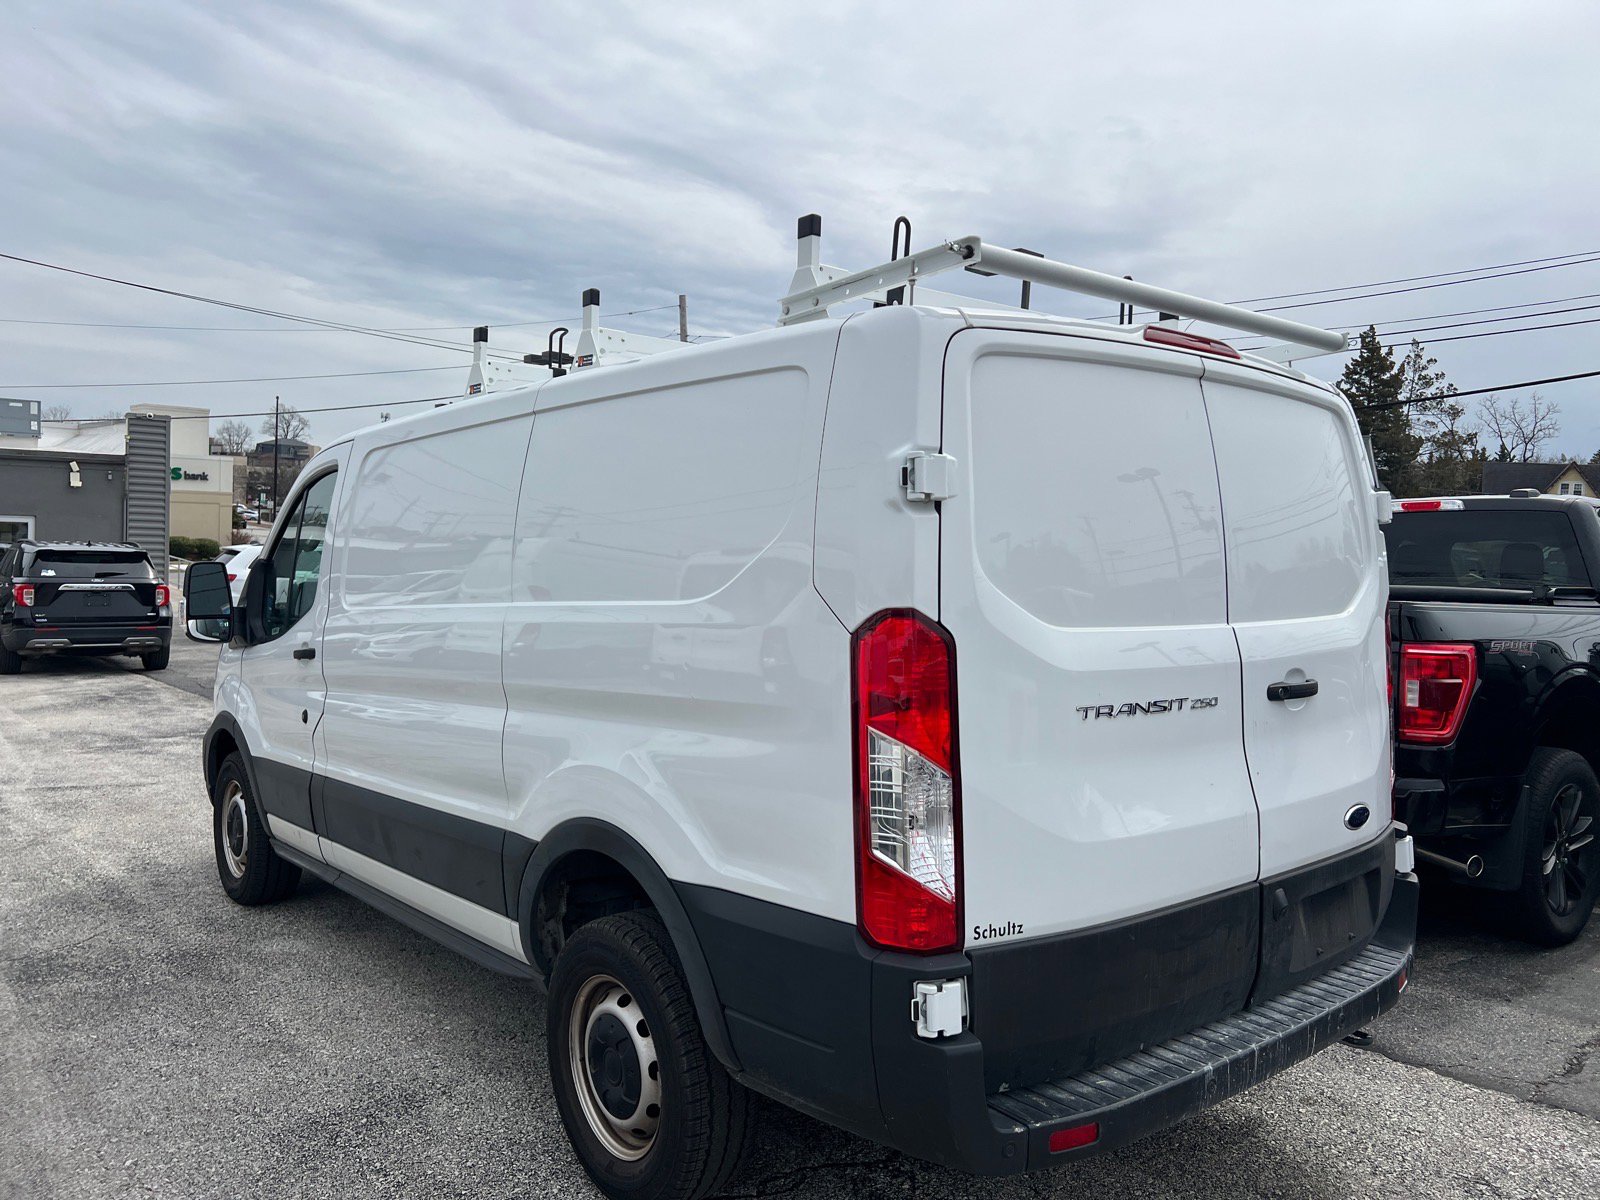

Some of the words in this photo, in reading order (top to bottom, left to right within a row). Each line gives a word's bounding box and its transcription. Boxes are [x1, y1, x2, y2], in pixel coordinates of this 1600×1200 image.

[170, 466, 182, 481] S
[184, 470, 209, 481] bank
[1489, 640, 1537, 654] SPORT
[1076, 697, 1189, 720] TRANSIT
[1190, 696, 1219, 710] 250
[973, 921, 1024, 940] Schultz
